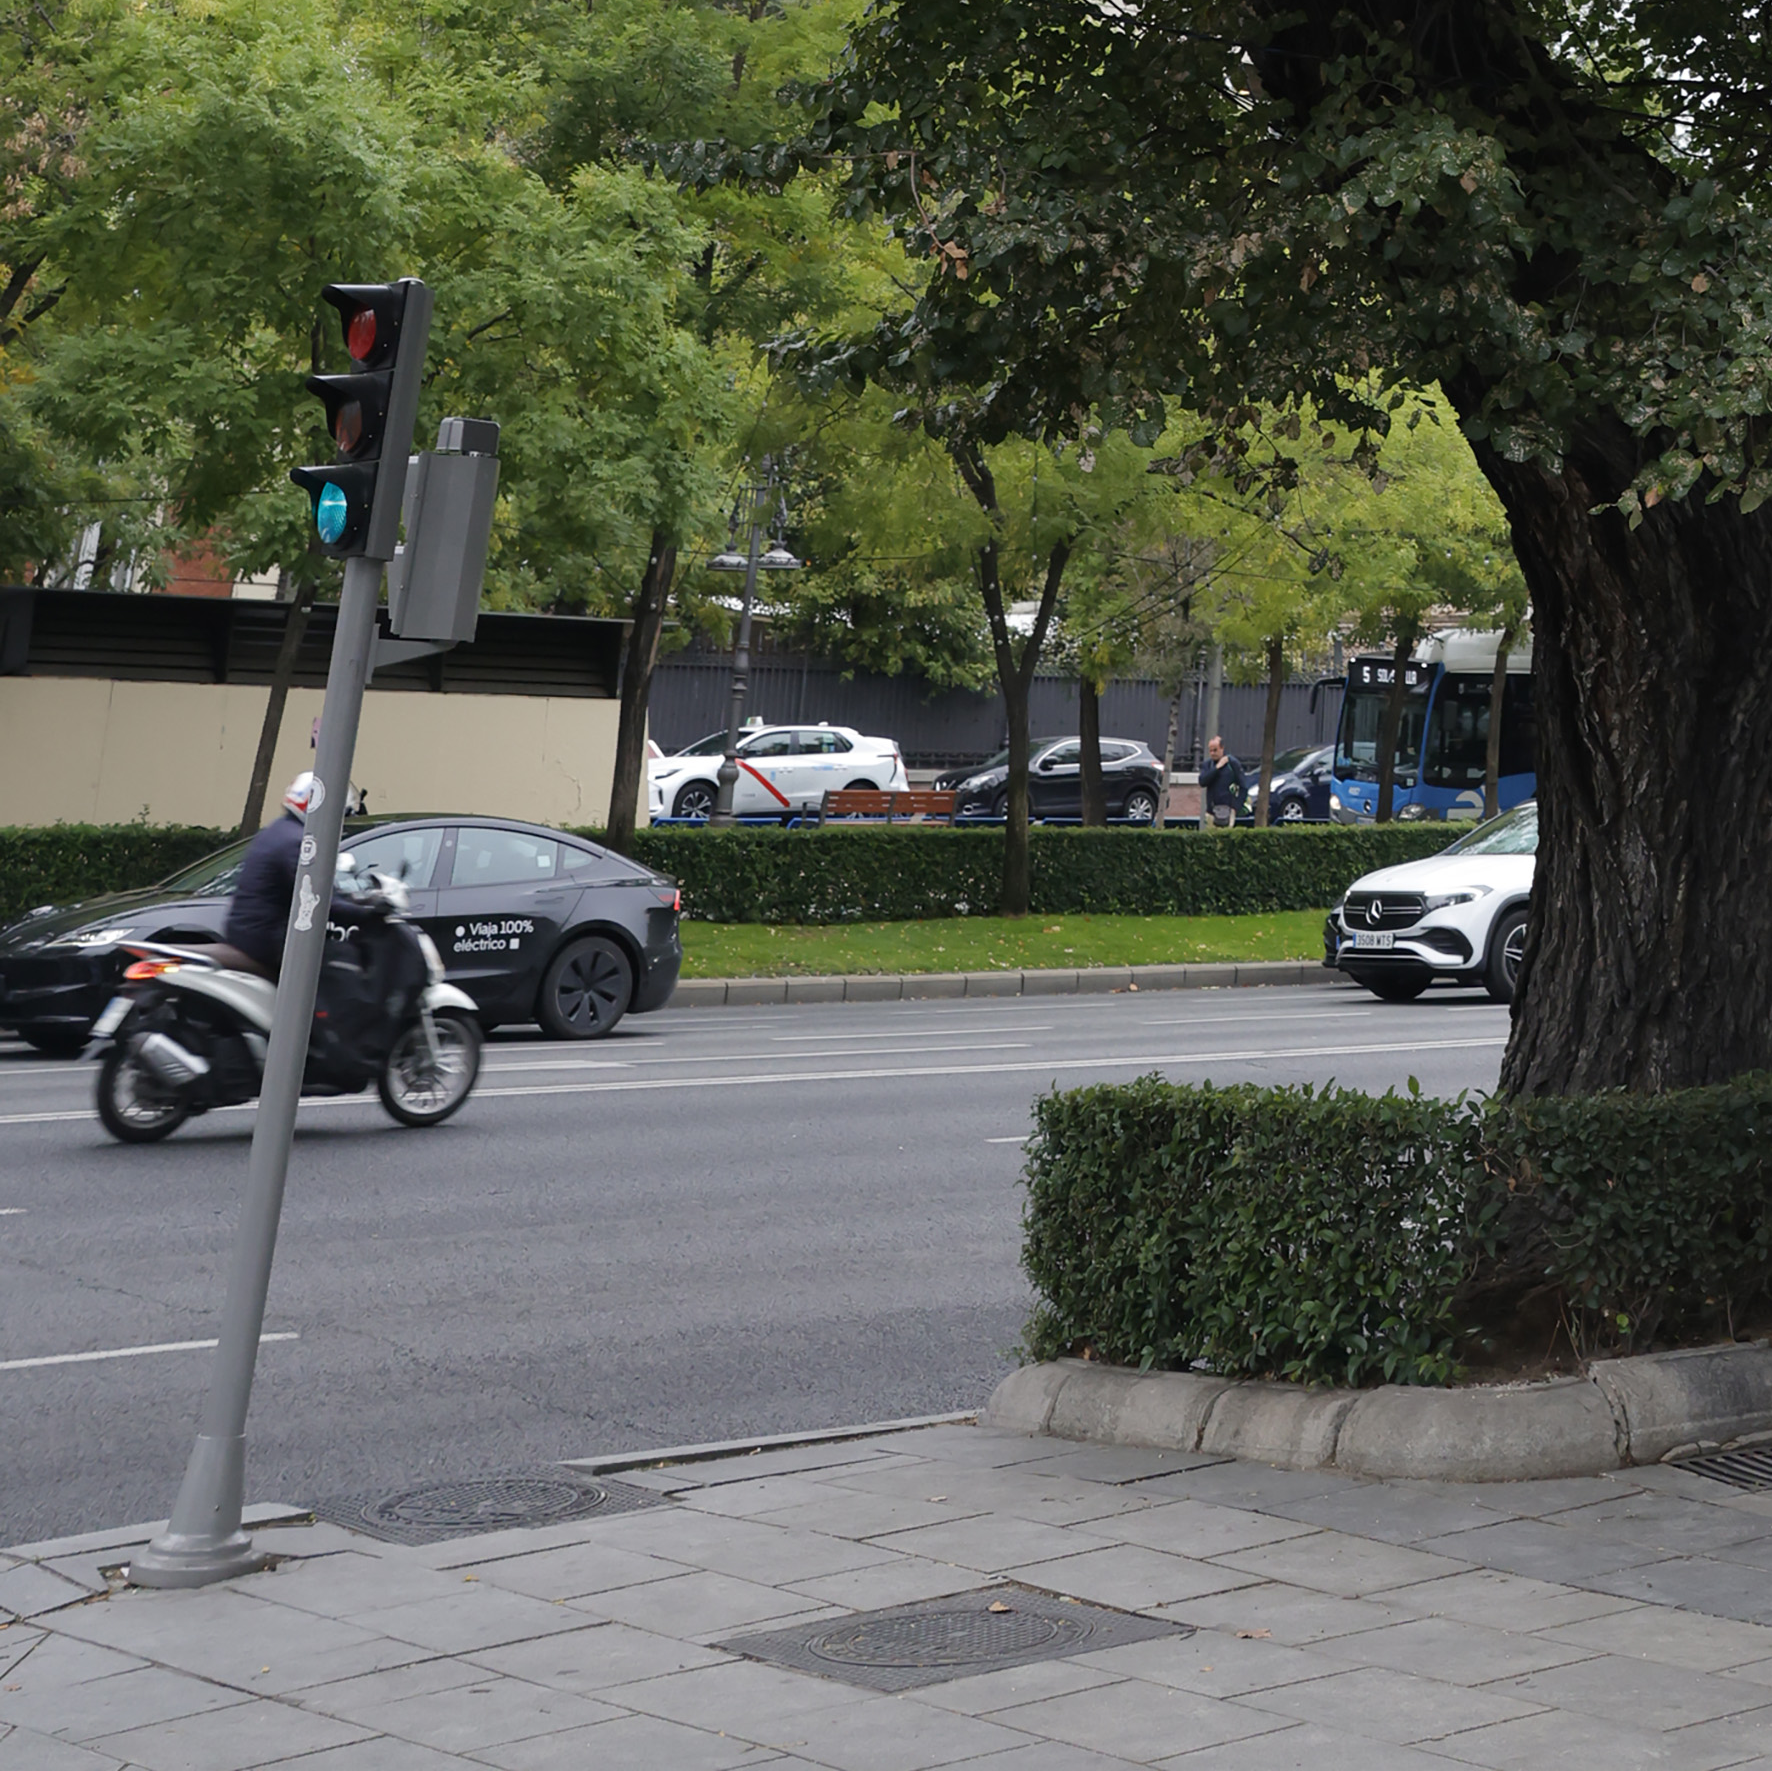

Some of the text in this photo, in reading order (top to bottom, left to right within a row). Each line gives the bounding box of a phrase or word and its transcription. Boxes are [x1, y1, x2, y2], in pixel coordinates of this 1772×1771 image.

[1363, 666, 1370, 683] 5
[469, 919, 534, 938] Viaja 100%
[453, 937, 507, 953] eléctrico
